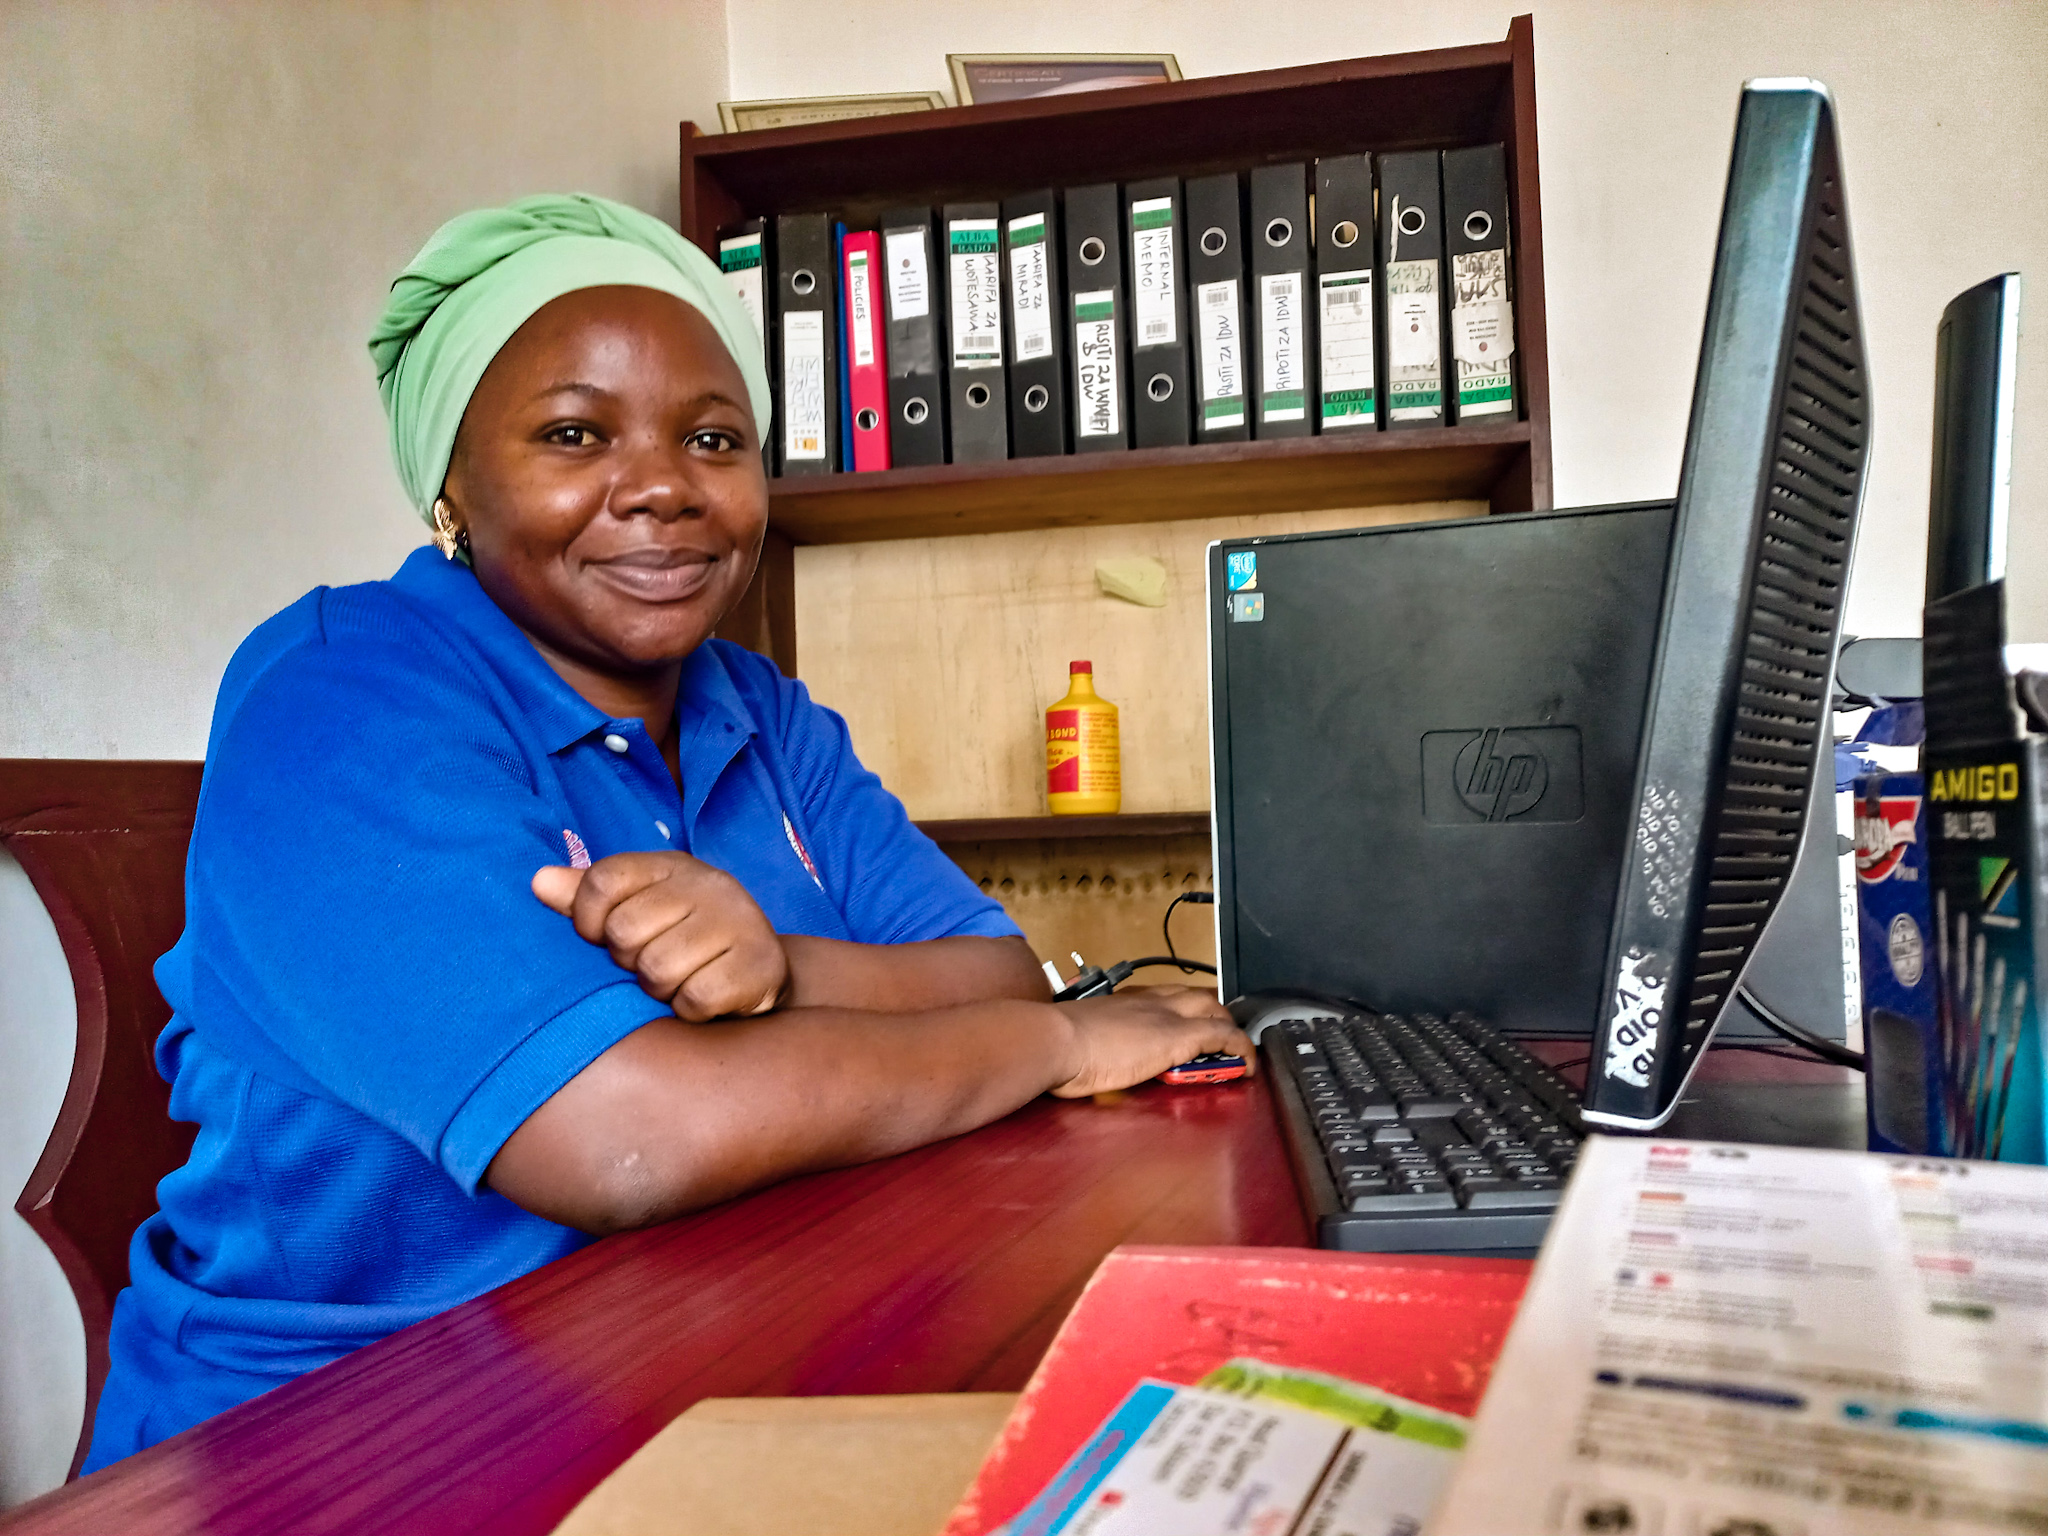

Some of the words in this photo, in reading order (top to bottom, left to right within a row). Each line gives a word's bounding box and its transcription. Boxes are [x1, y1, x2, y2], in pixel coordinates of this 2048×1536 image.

[957, 232, 991, 242] ALBA
[957, 243, 992, 254] RADO
[1140, 236, 1153, 288] MEMO
[1157, 231, 1171, 300] INTERNAL
[854, 275, 866, 320] POLICIES
[1017, 263, 1029, 310] MIRADI
[1274, 295, 1291, 322] IDW
[985, 312, 997, 329] ZA
[1215, 314, 1234, 341] IDW
[1278, 326, 1290, 346] ZA
[1219, 344, 1232, 362] ZA
[1275, 347, 1291, 389] RIPOTI
[1081, 364, 1096, 400] IDW
[1392, 380, 1437, 392] RADO
[1463, 374, 1508, 390] RADO
[1330, 391, 1368, 402] RADO
[1393, 393, 1437, 405] ALBA
[1464, 388, 1508, 402] ALBA
[1466, 728, 1538, 824] hp
[1930, 763, 2019, 801] AMIGO
